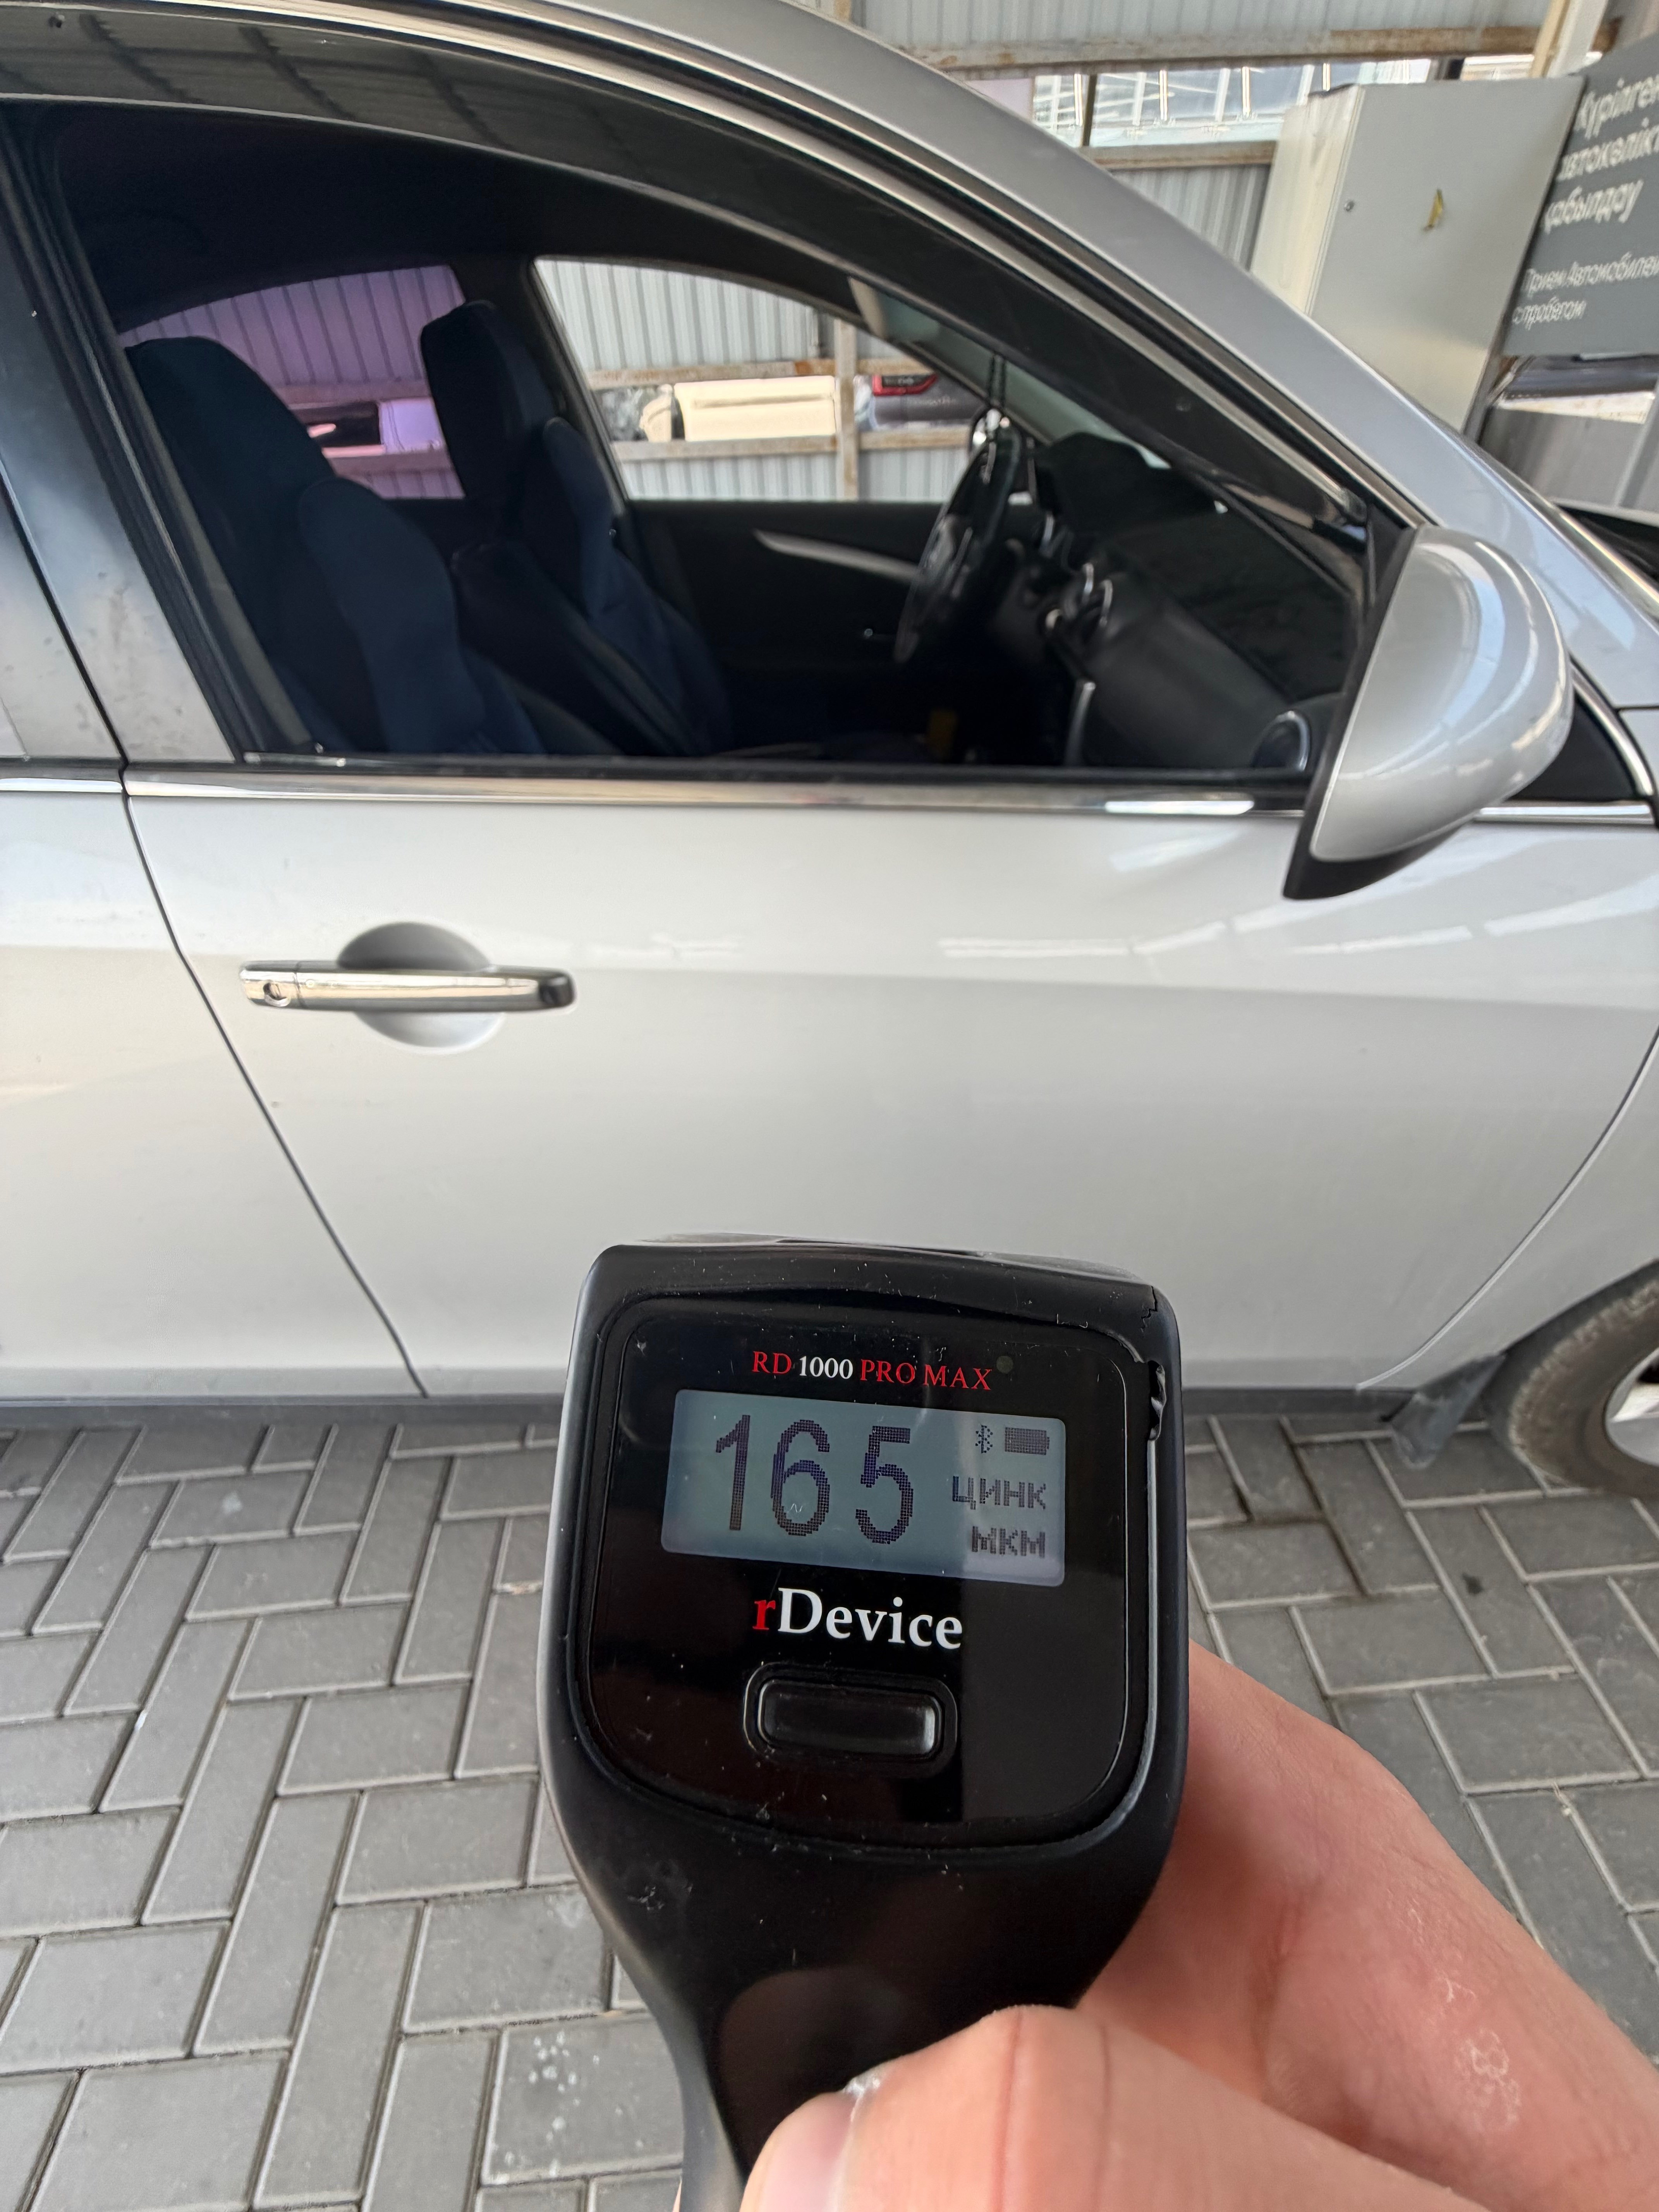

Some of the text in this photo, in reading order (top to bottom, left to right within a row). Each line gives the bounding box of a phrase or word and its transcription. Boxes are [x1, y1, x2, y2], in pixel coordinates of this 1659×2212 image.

[752, 1351, 992, 1390] RD 1000 PRO MAX
[716, 1414, 914, 1544] 165
[752, 1587, 963, 1650] rDevice
